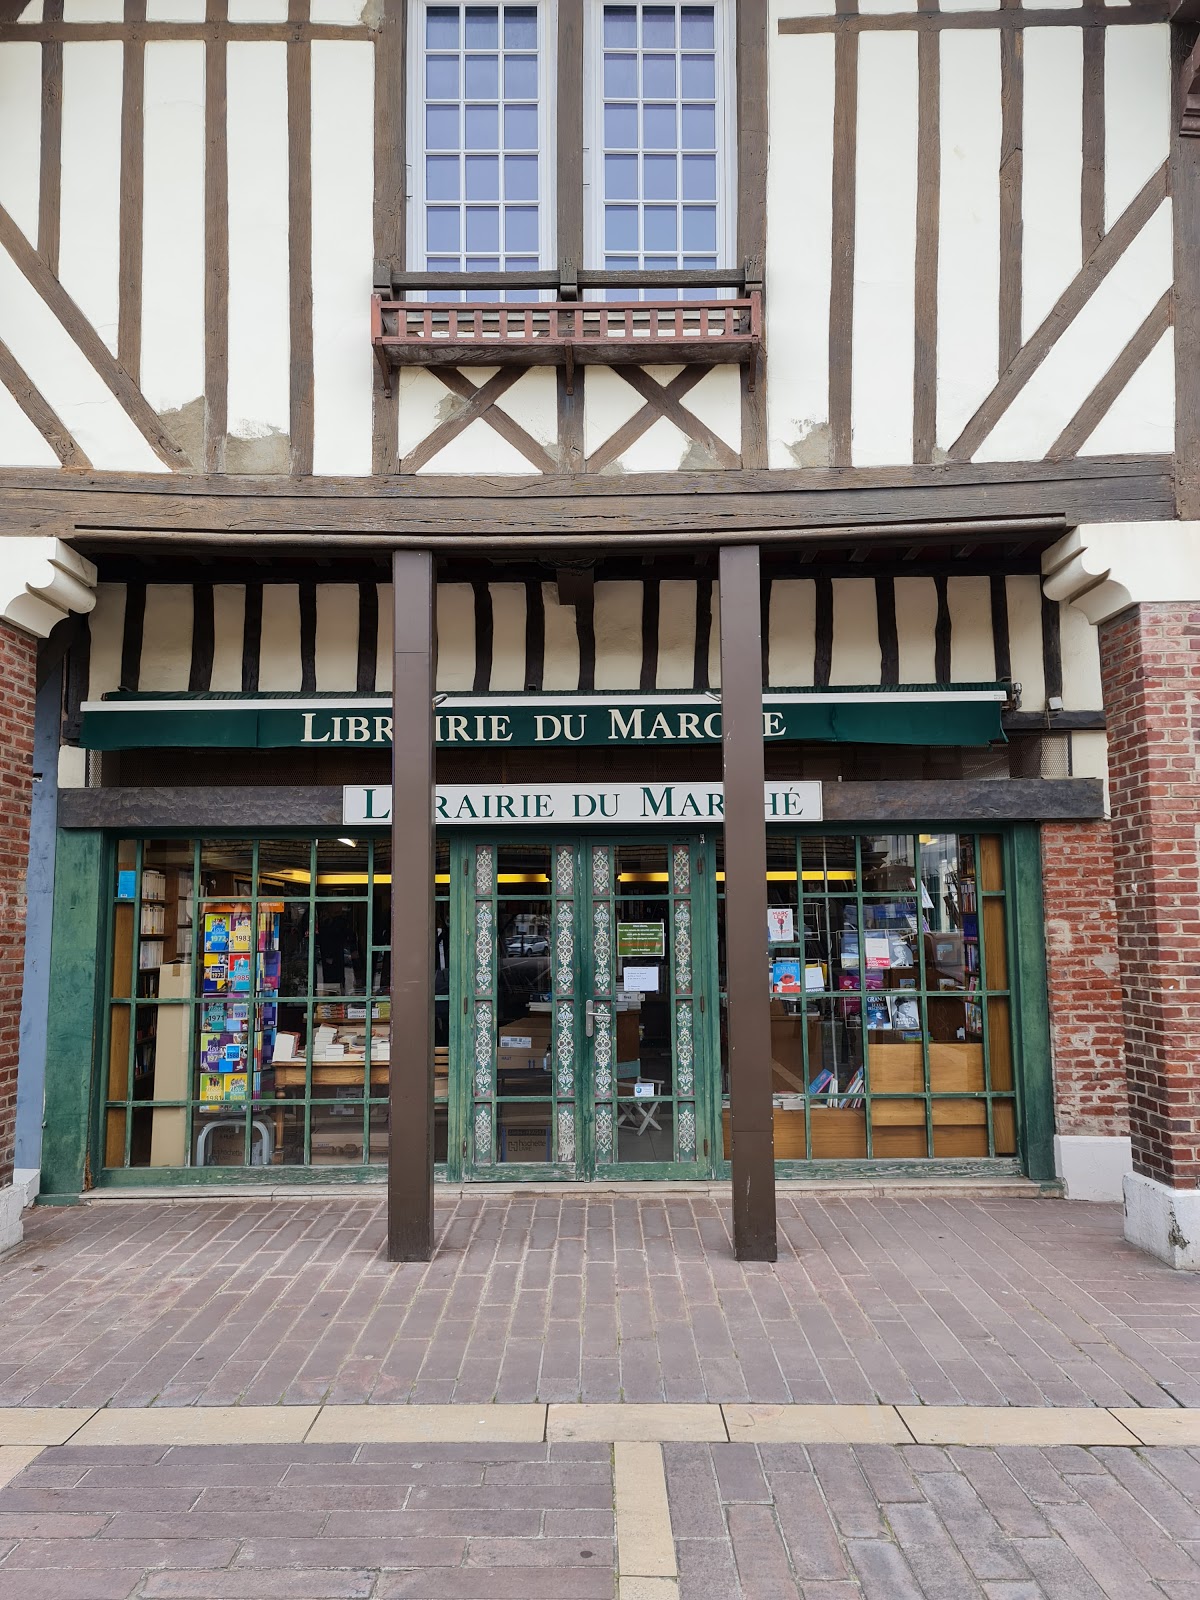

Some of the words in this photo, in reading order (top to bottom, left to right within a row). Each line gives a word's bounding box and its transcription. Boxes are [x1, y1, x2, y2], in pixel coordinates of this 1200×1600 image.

[300, 712, 513, 742] LIBRIRIE
[534, 714, 587, 741] DU
[608, 708, 787, 739] MARCE
[362, 788, 554, 819] LRAIRIE
[572, 793, 620, 818] DU
[640, 786, 804, 818] MARHÉ
